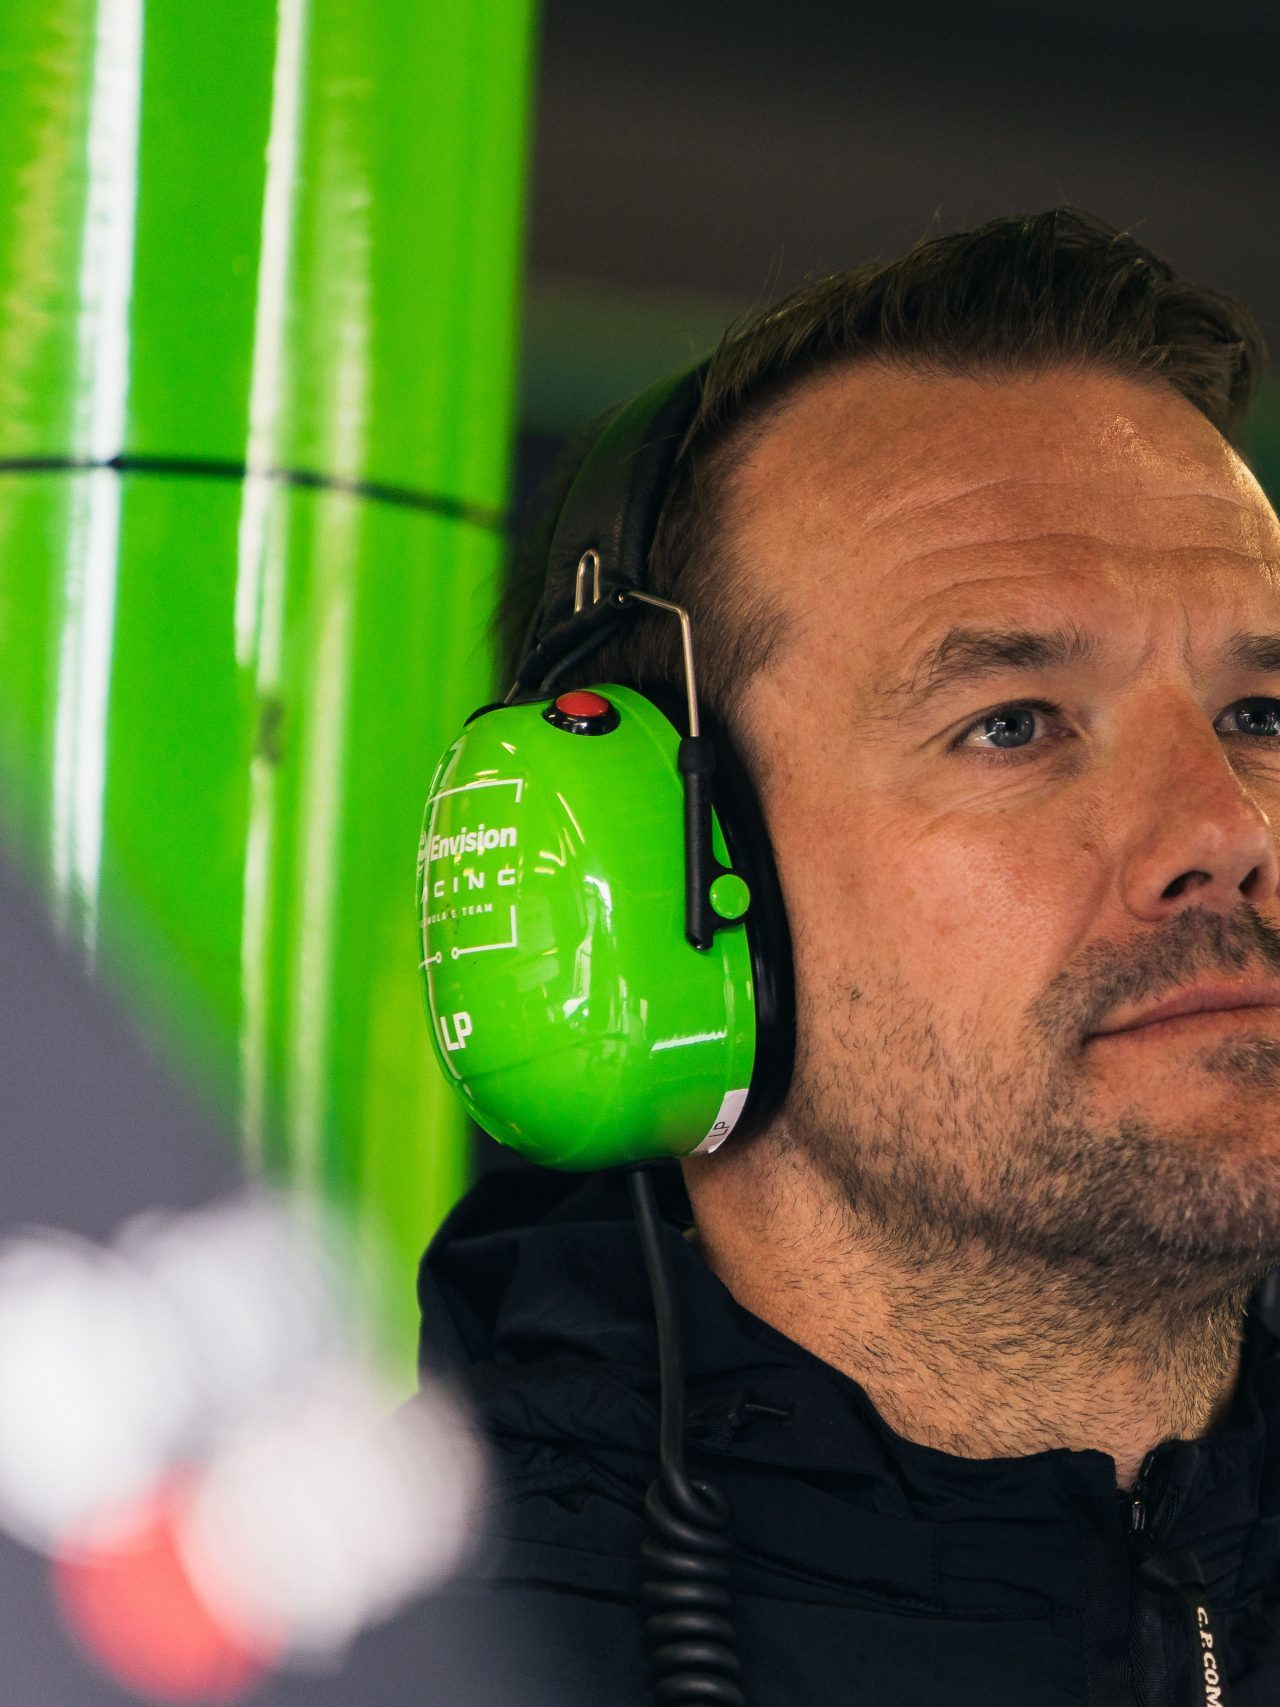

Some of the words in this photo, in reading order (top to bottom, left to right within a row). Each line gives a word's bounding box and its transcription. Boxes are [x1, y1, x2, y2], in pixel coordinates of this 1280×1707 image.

[430, 824, 516, 861] Envision
[462, 903, 493, 916] TEAM
[440, 1011, 473, 1052] LP
[708, 1121, 730, 1138] LP
